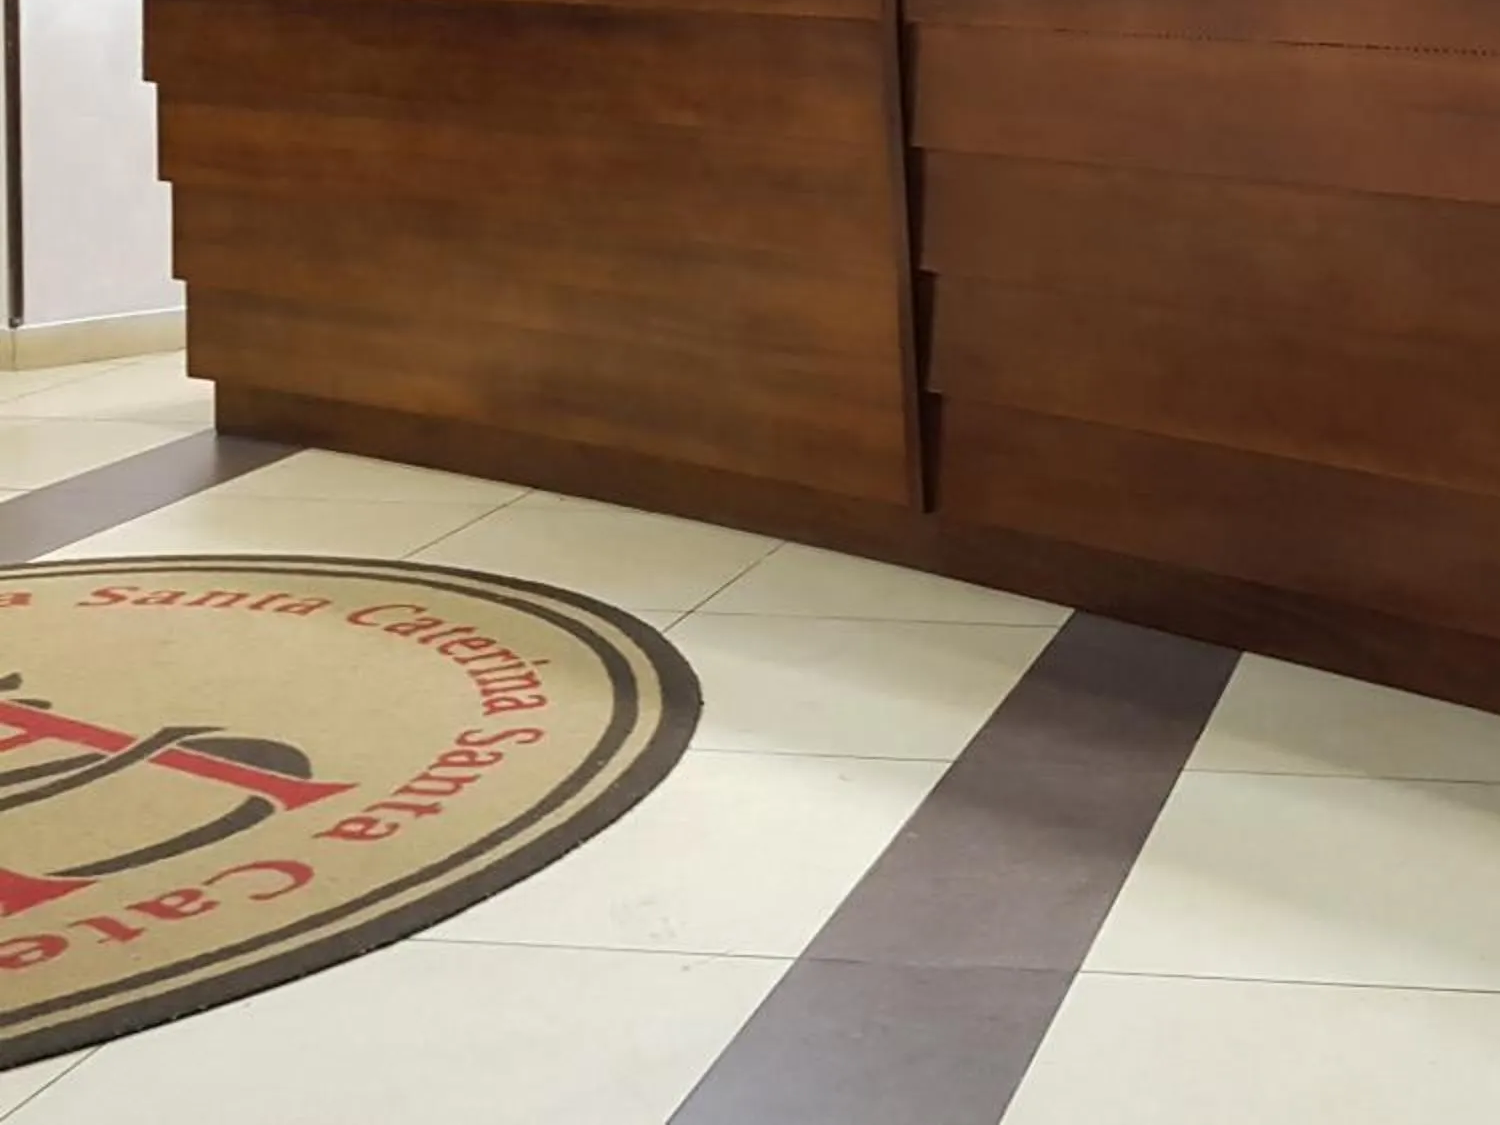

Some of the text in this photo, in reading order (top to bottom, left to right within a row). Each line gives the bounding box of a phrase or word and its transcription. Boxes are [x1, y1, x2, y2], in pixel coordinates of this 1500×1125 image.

[75, 585, 334, 617] Santa
[346, 603, 551, 717] Caterina
[310, 727, 545, 843] Santa
